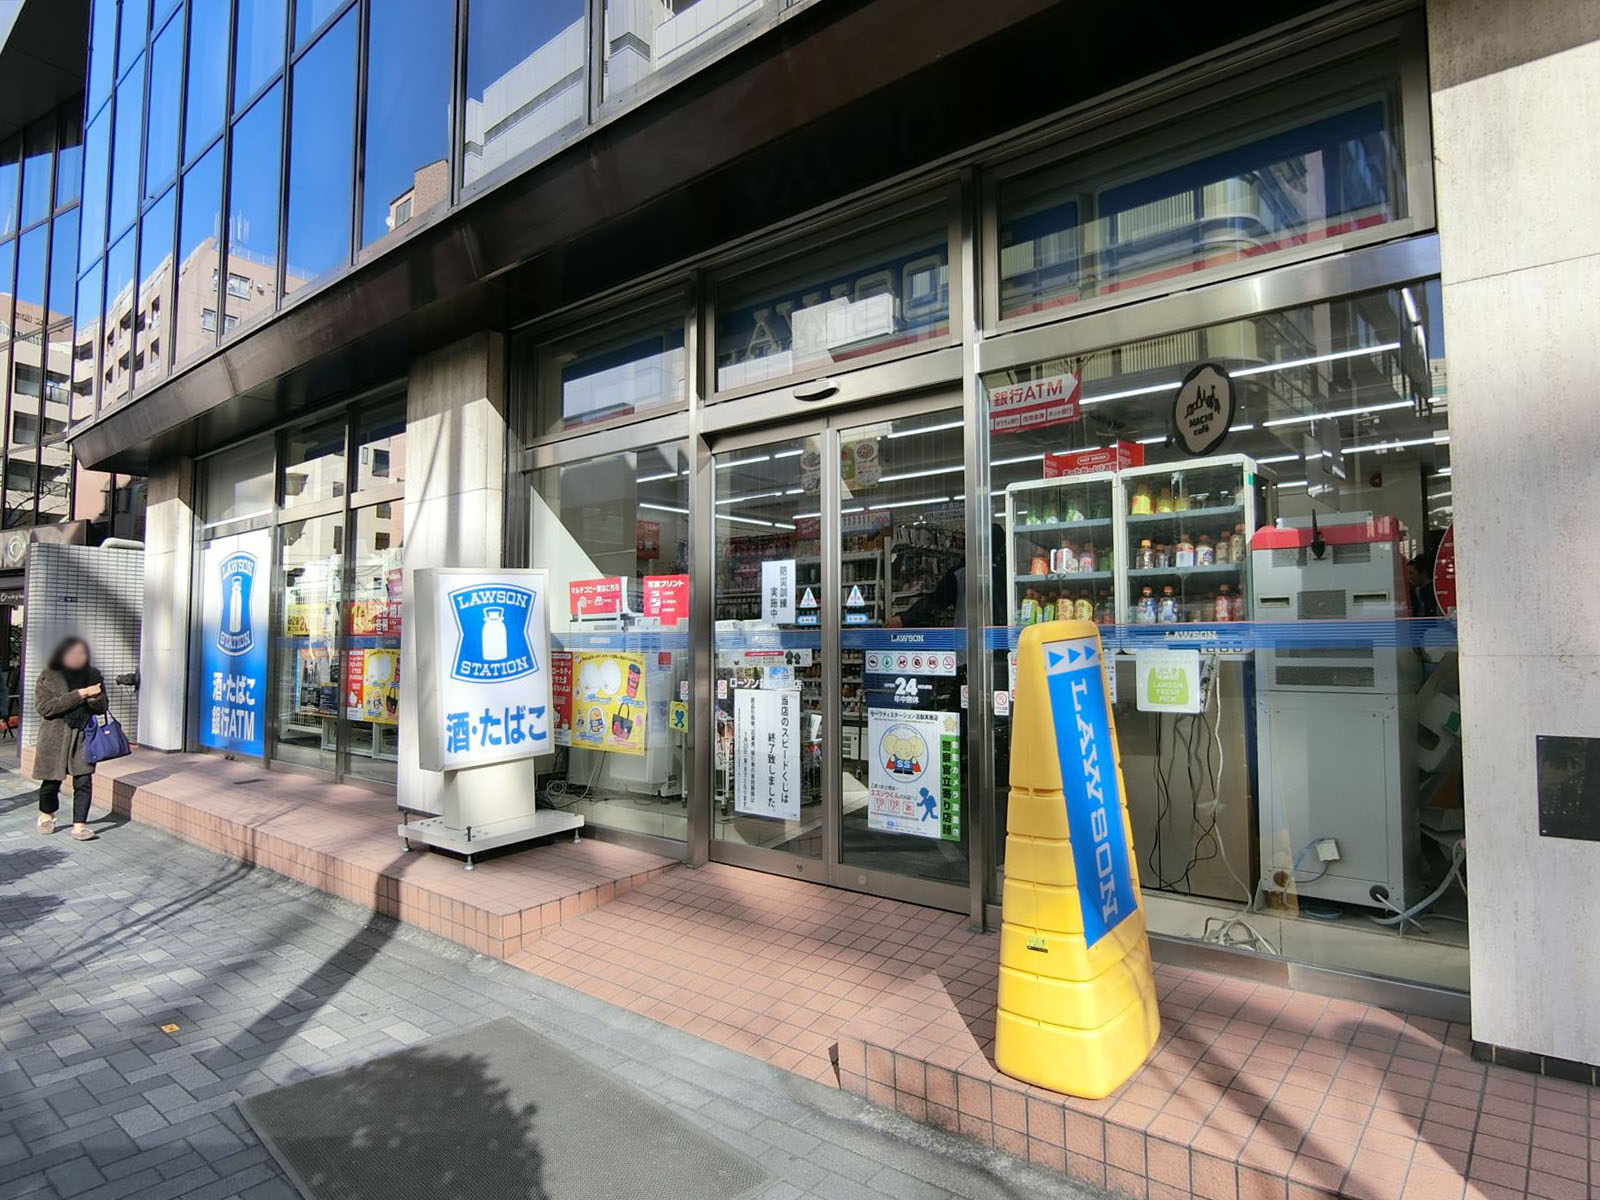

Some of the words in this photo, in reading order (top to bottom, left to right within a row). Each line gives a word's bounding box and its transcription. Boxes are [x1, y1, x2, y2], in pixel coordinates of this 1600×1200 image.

[994, 379, 1063, 407] 銀行ATM
[1189, 412, 1214, 428] MACHI
[222, 558, 254, 579] LAWSON
[779, 566, 788, 608] 防災訓練
[457, 590, 529, 610] LAWSON
[770, 587, 778, 618] 実施中
[219, 631, 251, 650] STATION
[890, 634, 924, 643] LAWSON
[1165, 630, 1217, 640] LAWSON
[460, 656, 529, 677] STATION
[212, 671, 256, 706] 酒・たばこ
[894, 676, 918, 696] 24
[211, 705, 256, 742] 銀行ATM
[446, 705, 547, 753] 酒・たばこ
[781, 694, 789, 804] 当店のスピードくじは
[1071, 677, 1119, 923] LAWSON
